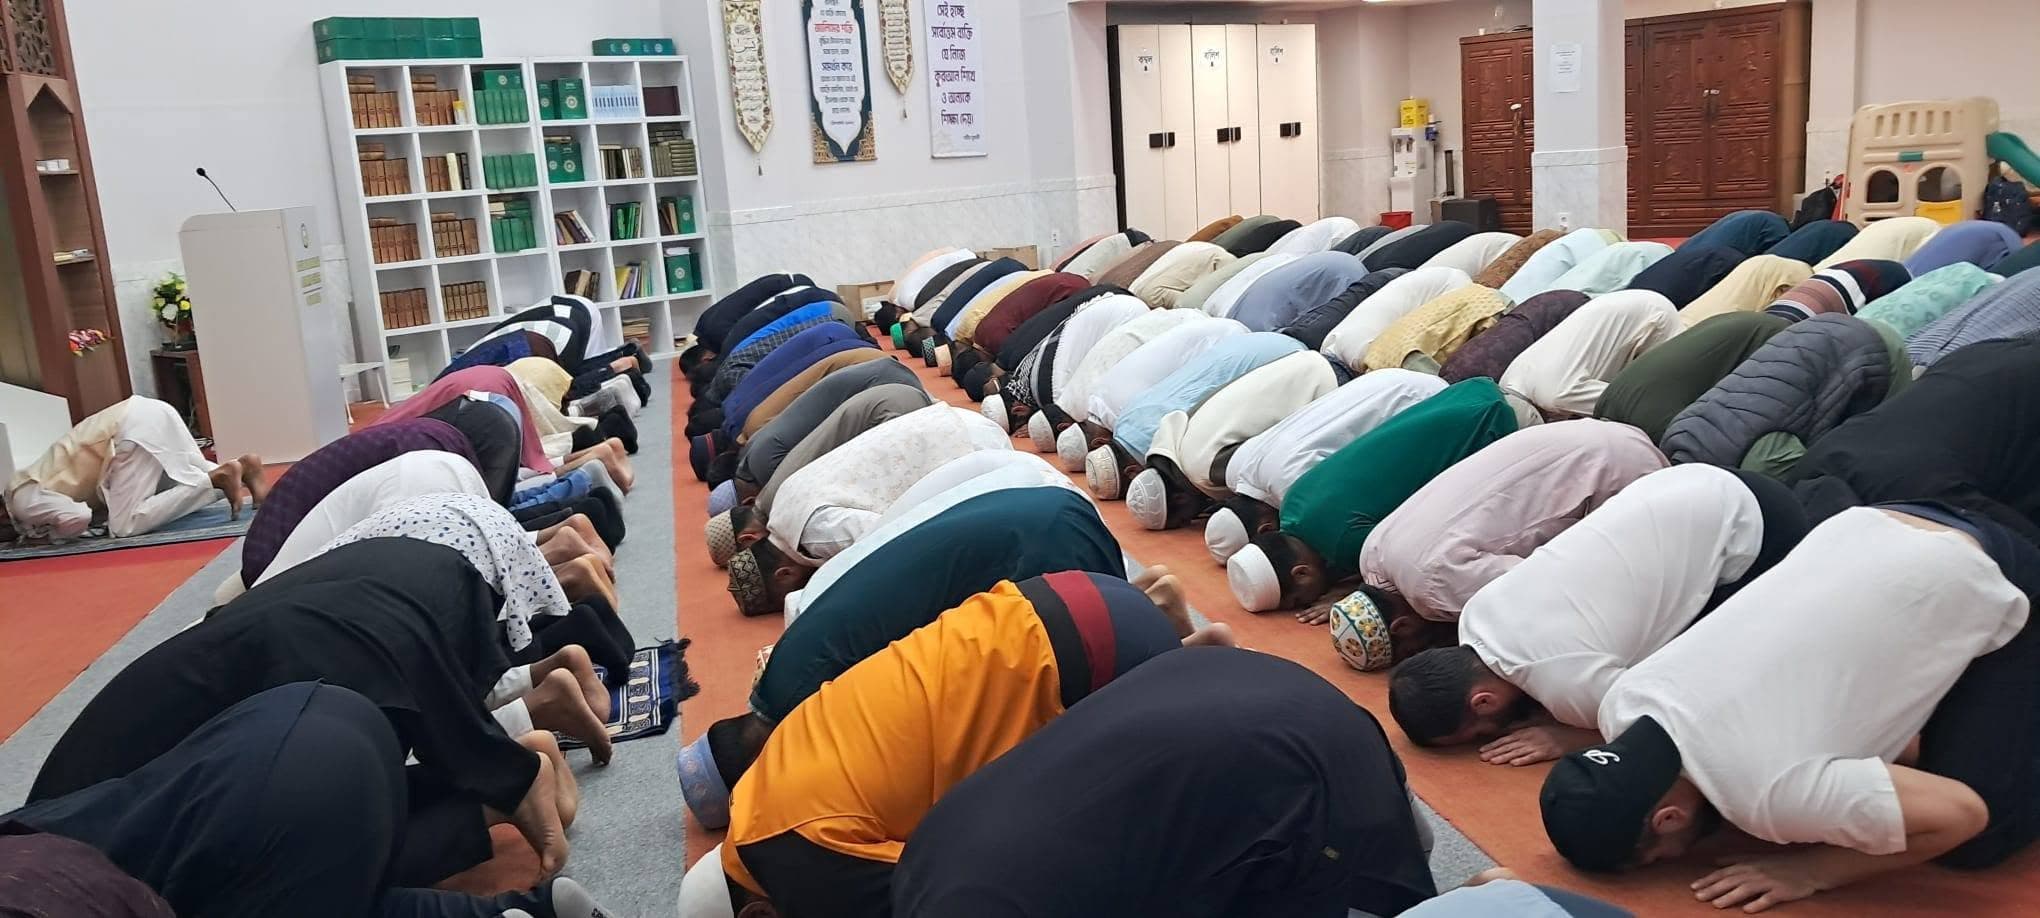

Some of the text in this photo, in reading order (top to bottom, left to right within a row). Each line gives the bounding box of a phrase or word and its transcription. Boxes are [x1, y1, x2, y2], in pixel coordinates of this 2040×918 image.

[937, 1, 966, 18] সেই হচ্ছে
[942, 44, 966, 60] যে নিজে
[934, 70, 960, 87] কুরআন
[942, 92, 947, 104] ও
